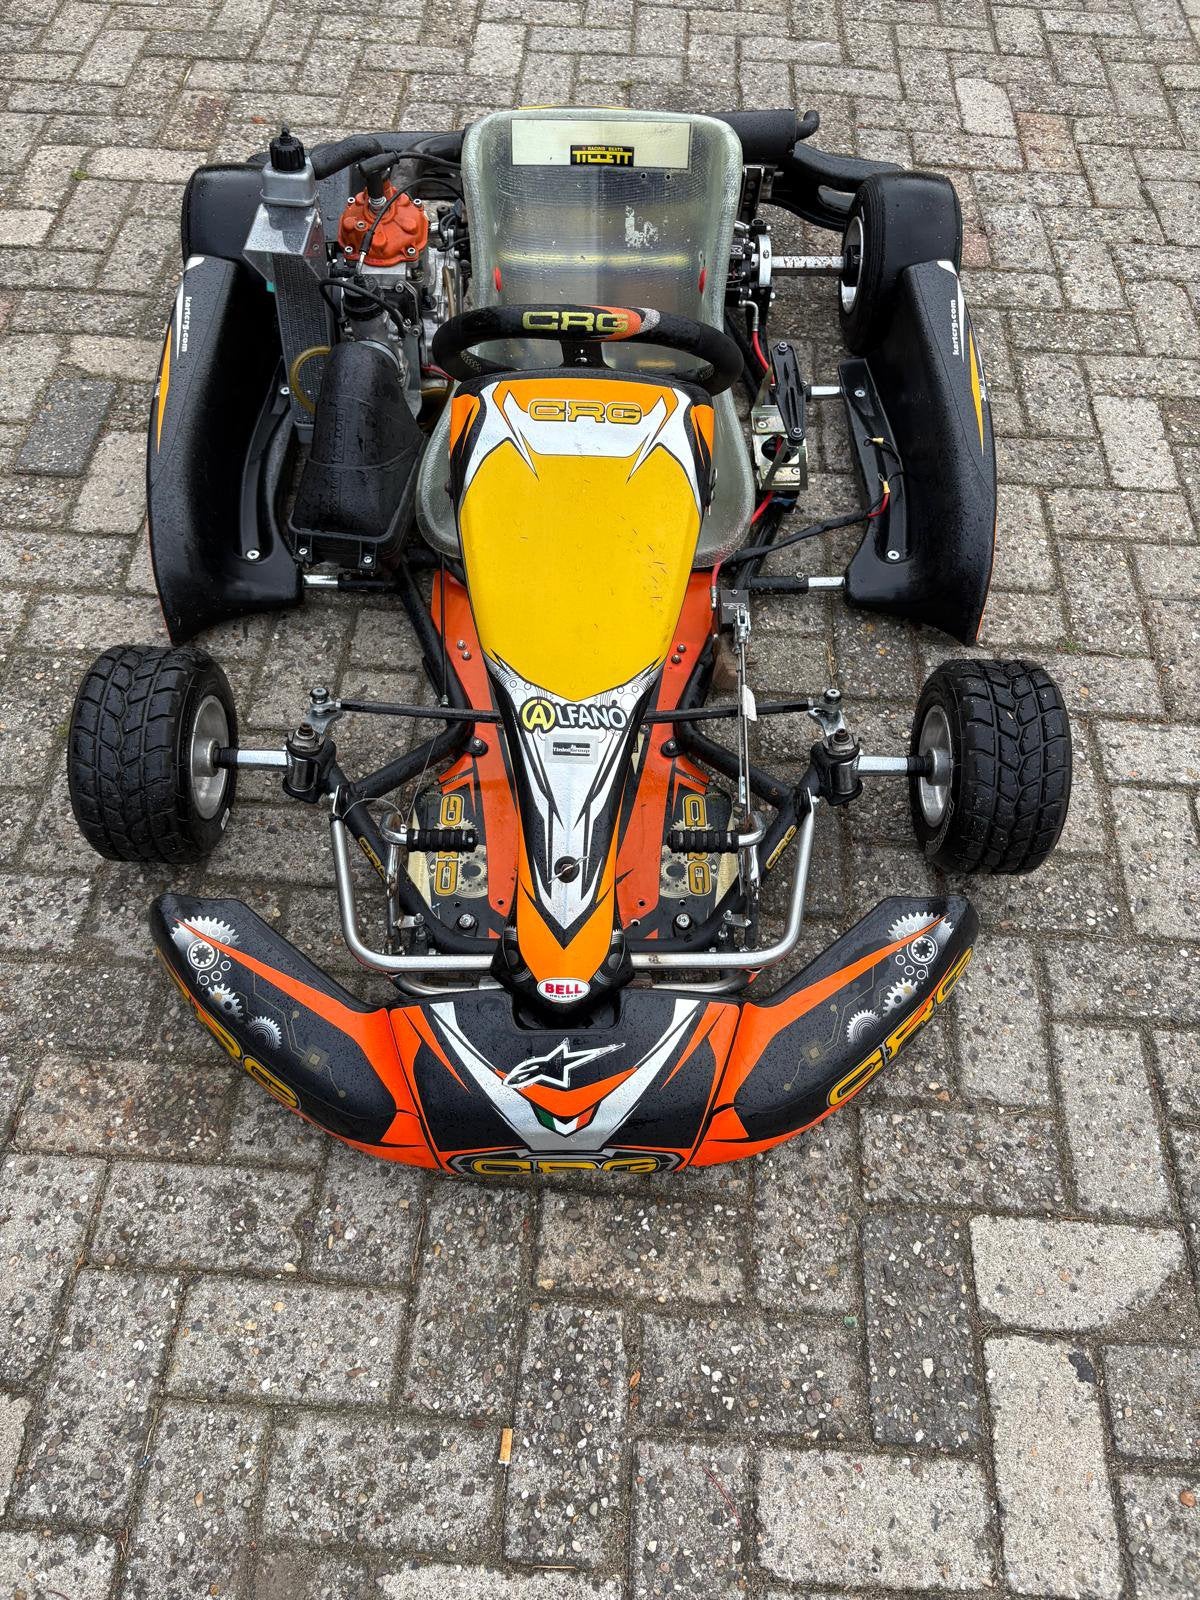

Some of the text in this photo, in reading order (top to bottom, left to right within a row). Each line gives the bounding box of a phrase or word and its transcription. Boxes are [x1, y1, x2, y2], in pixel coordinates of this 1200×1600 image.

[572, 151, 633, 164] TILLETT
[181, 296, 192, 352] kartcrg.com
[522, 311, 630, 332] CRG
[950, 299, 960, 356] kartcrg.com
[529, 400, 643, 425] CRG
[521, 697, 628, 732] ALFANO
[434, 793, 464, 896] CG
[682, 793, 712, 896] CG
[765, 824, 798, 870] CRG
[545, 983, 583, 995] BELL
[827, 945, 974, 1107] CRG
